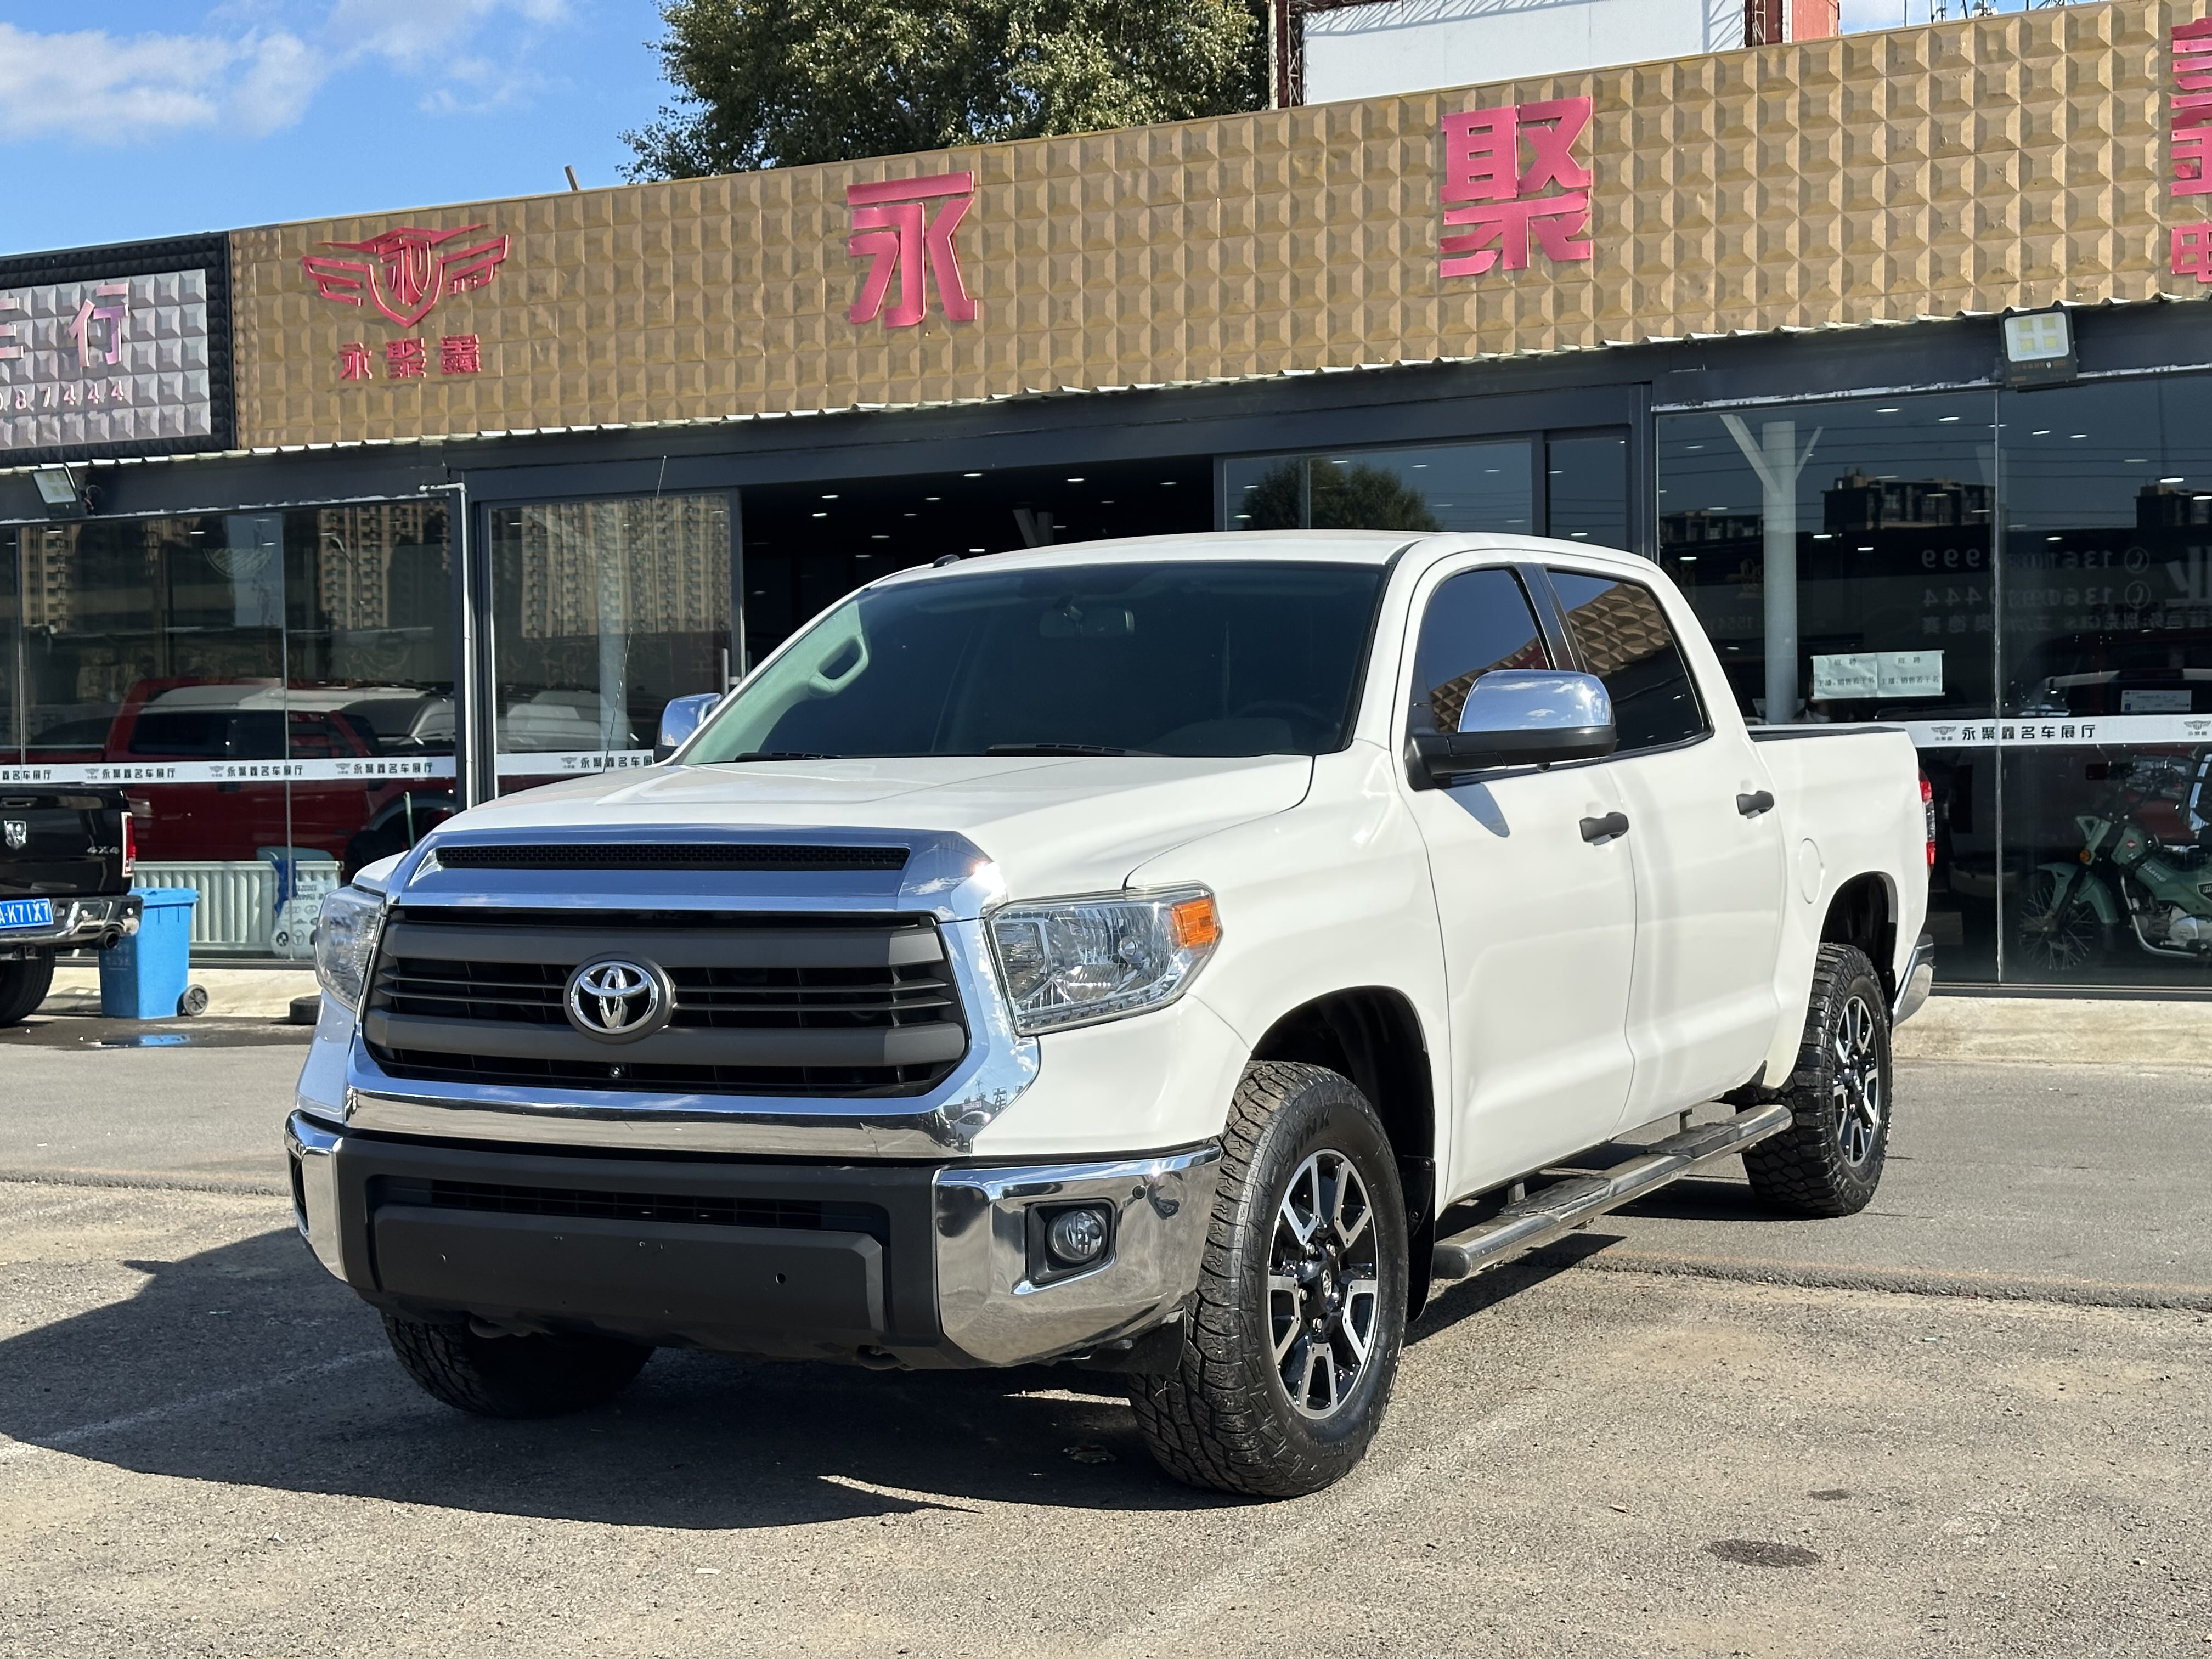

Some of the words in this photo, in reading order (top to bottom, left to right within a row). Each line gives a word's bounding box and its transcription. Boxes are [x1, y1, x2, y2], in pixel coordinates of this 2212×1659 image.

[339, 334, 481, 381] 永聚鑫
[0, 380, 124, 410] 87444
[1961, 724, 2097, 741] 永聚鑫名车展厅
